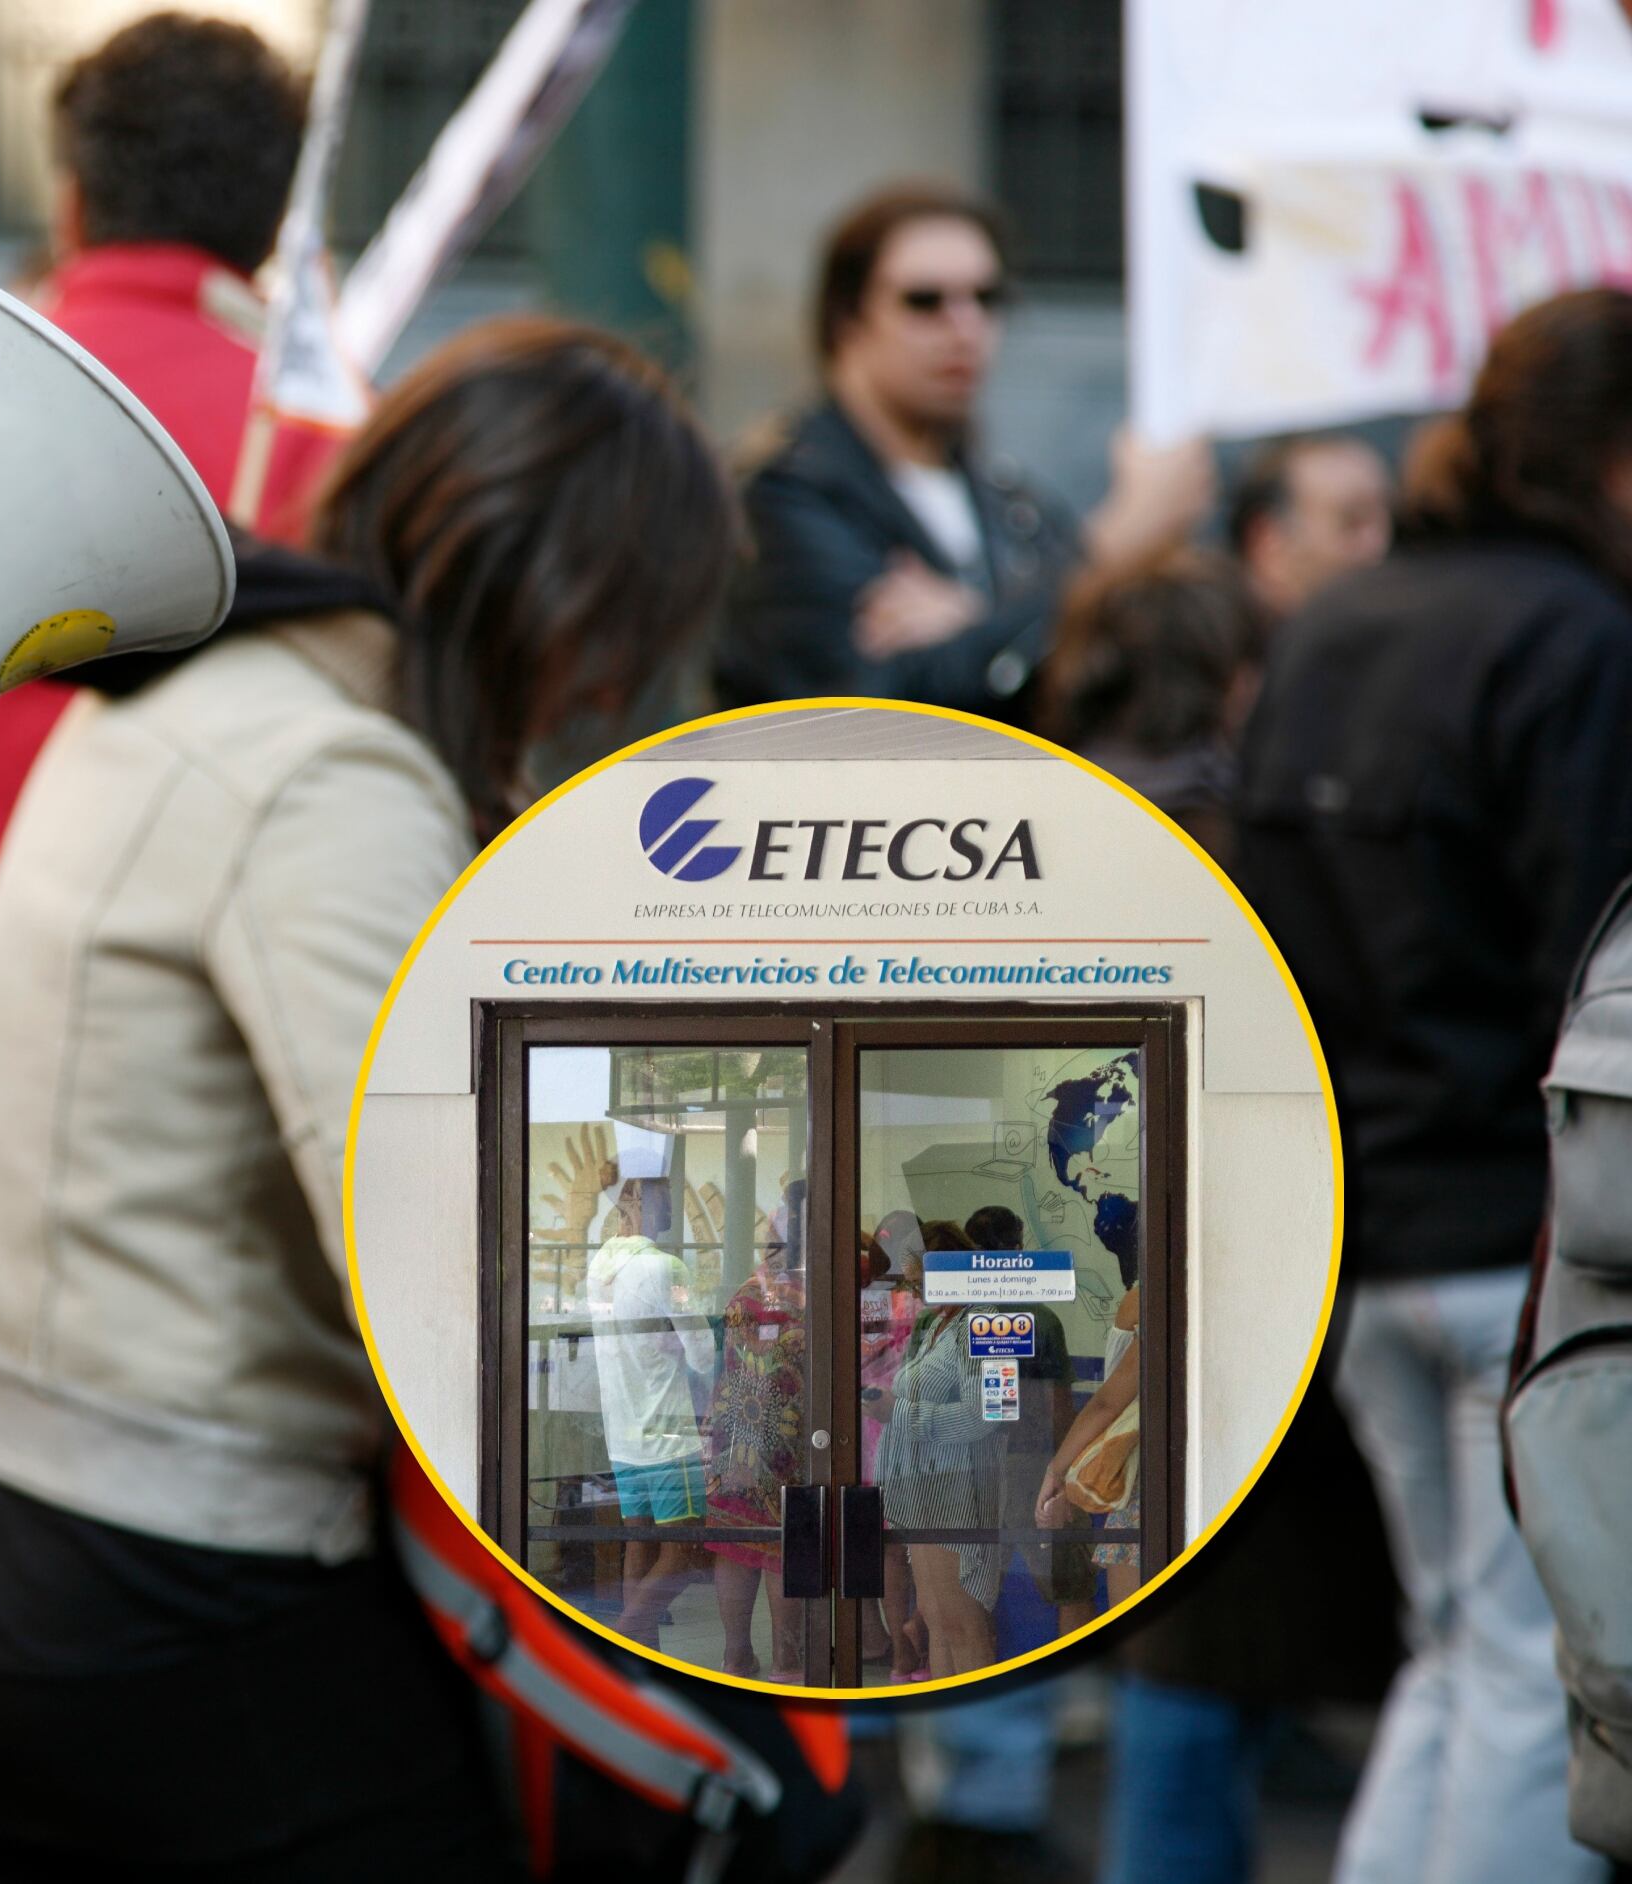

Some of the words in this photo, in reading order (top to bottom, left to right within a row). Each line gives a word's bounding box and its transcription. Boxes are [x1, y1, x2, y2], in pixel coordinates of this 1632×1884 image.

[748, 819, 1043, 881] ETECSA
[634, 903, 706, 918] EMPRESA
[712, 903, 734, 918] DE
[739, 902, 930, 917] TELECOMUNICACIONES
[936, 902, 957, 916] DE
[963, 901, 1009, 915] CUBA
[1014, 901, 1043, 915] S.A.
[502, 958, 602, 986] Centro
[610, 957, 819, 985] Multiservicios
[828, 955, 866, 984] de
[877, 956, 1173, 985] Telecomunicaciones
[971, 1254, 1034, 1269] Horario
[967, 1275, 991, 1284] Lunes
[1000, 1275, 1037, 1285] domingo
